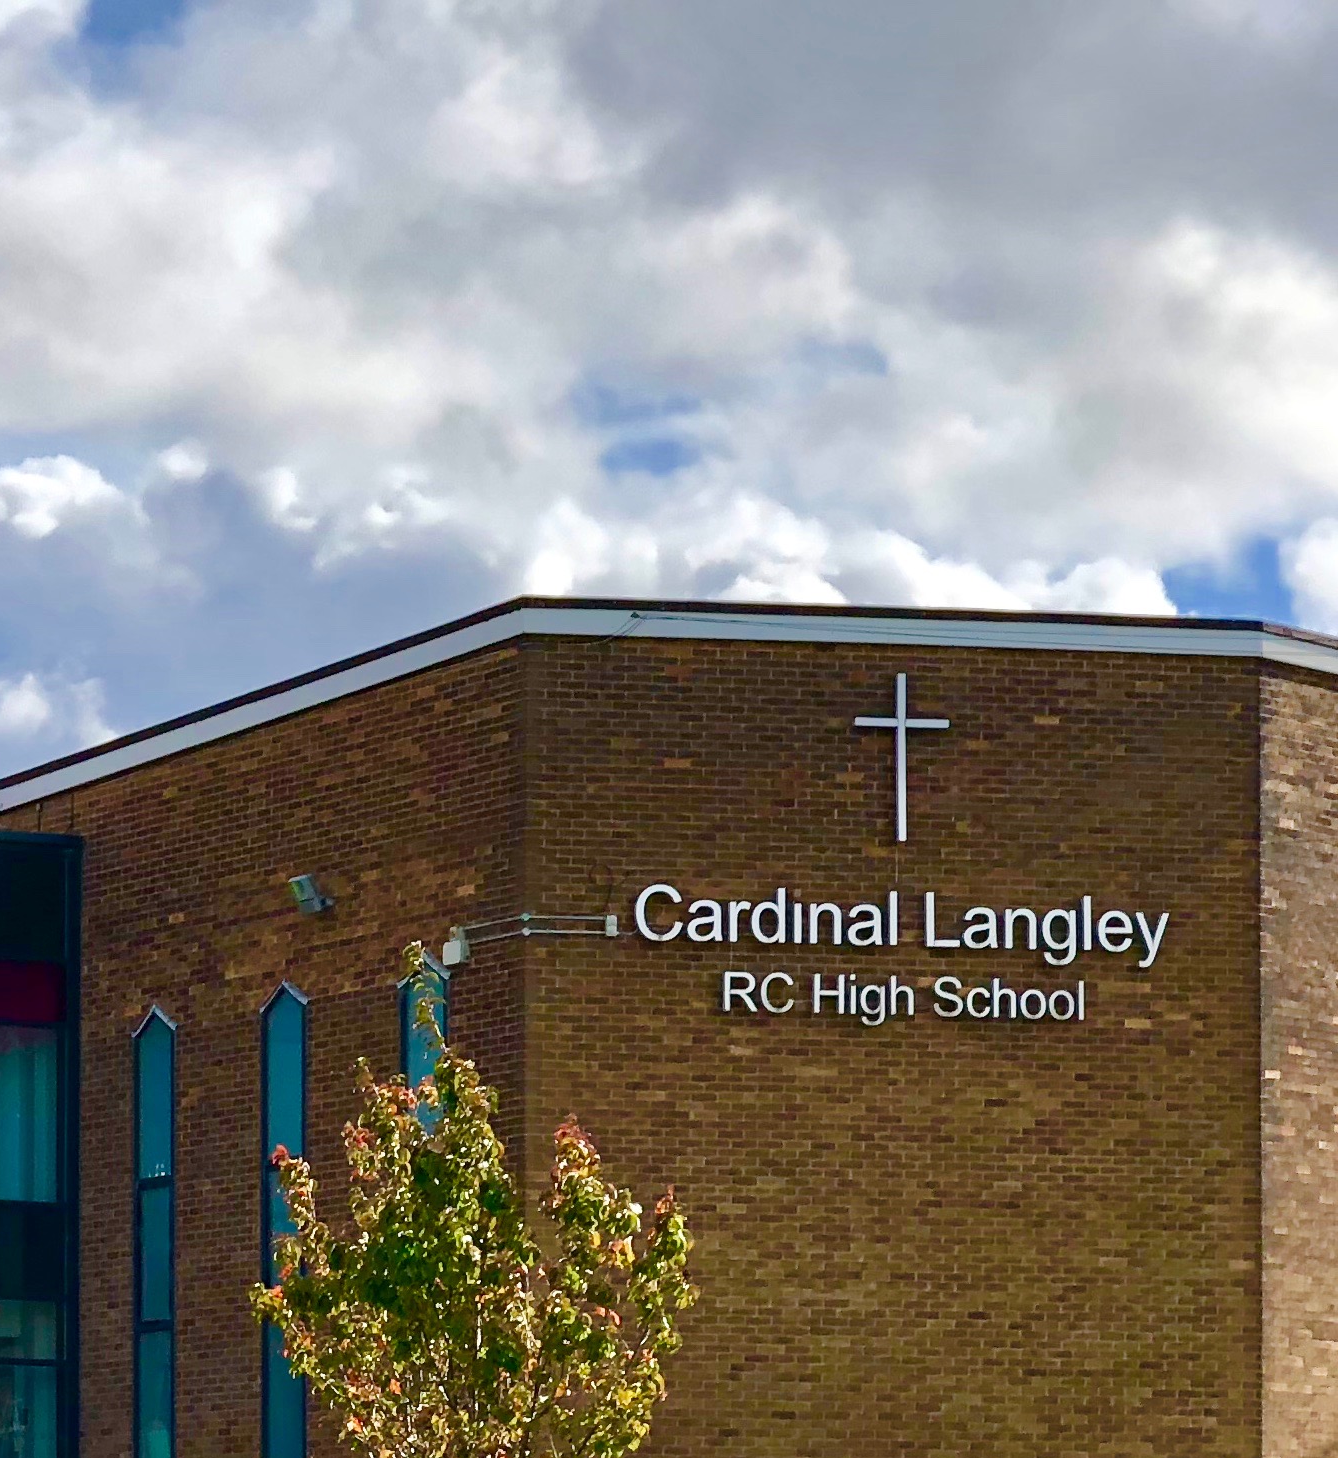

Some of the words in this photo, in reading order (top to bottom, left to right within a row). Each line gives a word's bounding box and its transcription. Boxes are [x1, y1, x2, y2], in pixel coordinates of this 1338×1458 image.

[634, 883, 898, 946] Cardinal
[925, 891, 1170, 968] Langley
[723, 970, 794, 1014] RC
[812, 972, 915, 1026] High
[933, 976, 1085, 1021] School
